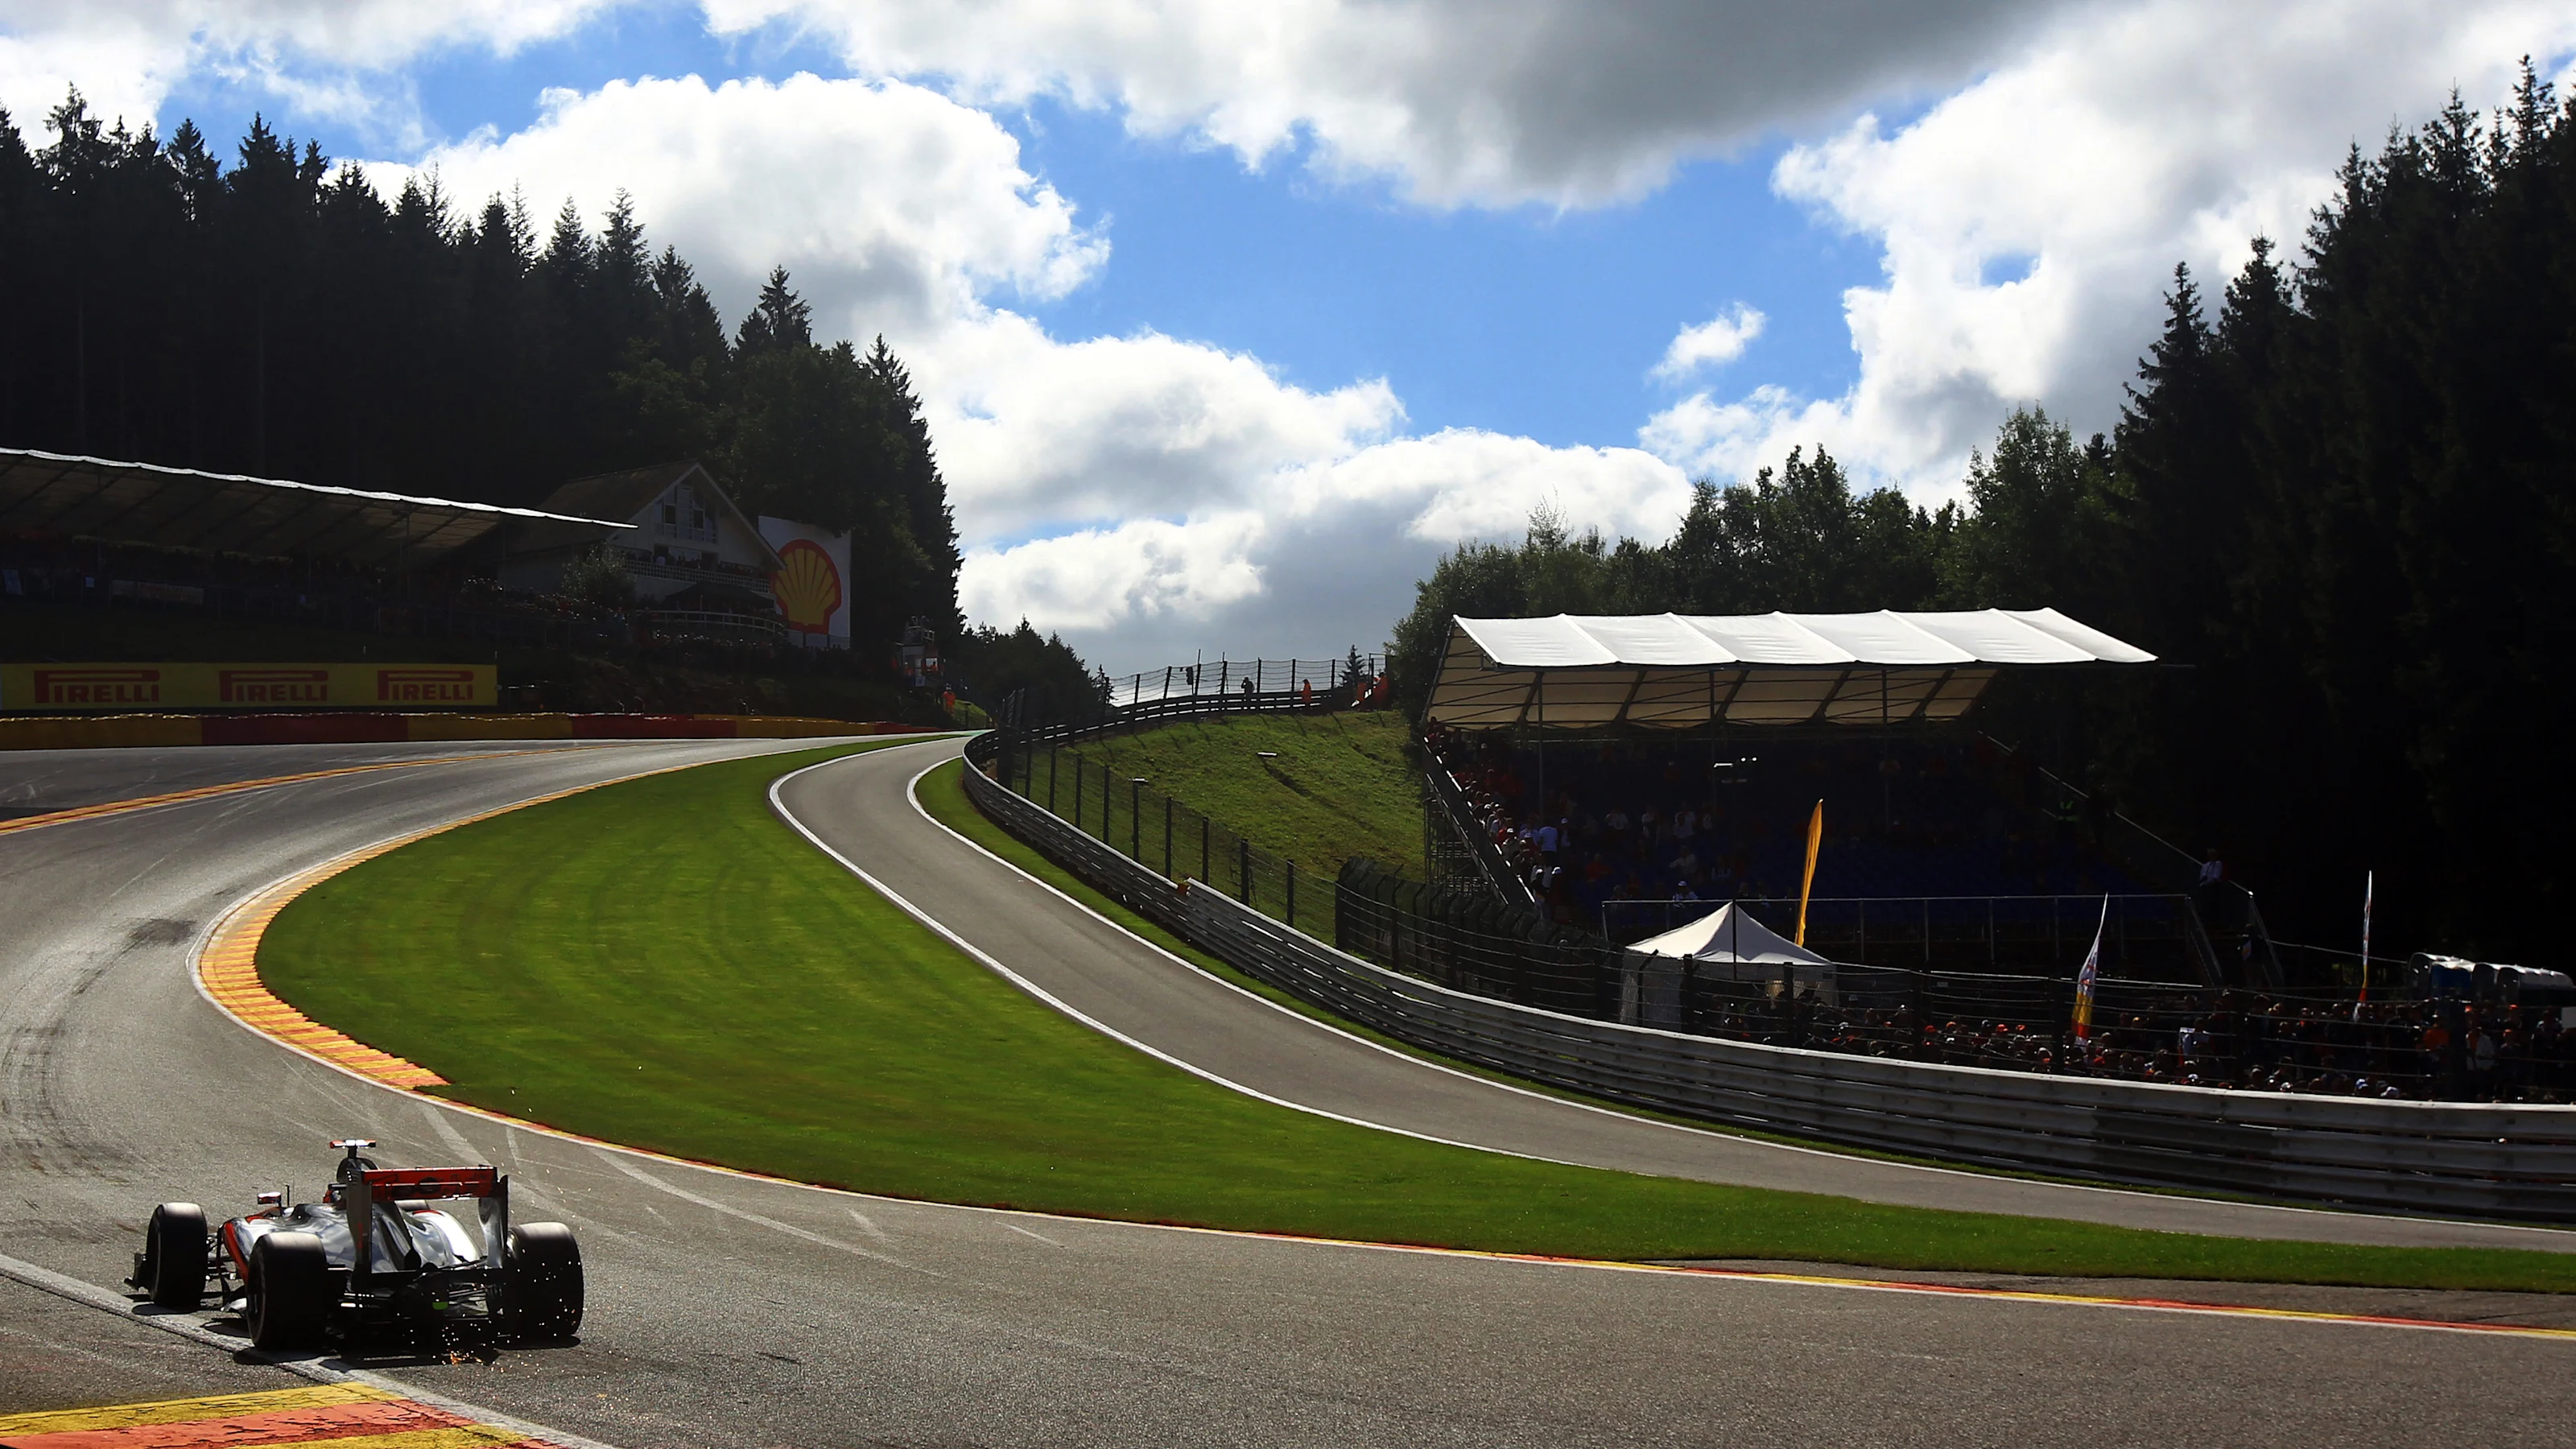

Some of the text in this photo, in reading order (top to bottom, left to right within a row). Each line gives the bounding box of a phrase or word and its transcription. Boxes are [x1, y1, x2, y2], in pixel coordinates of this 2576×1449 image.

[34, 670, 160, 703] PIRELLI
[218, 670, 328, 702] PIRELLI
[377, 670, 474, 700] PIRELLI
